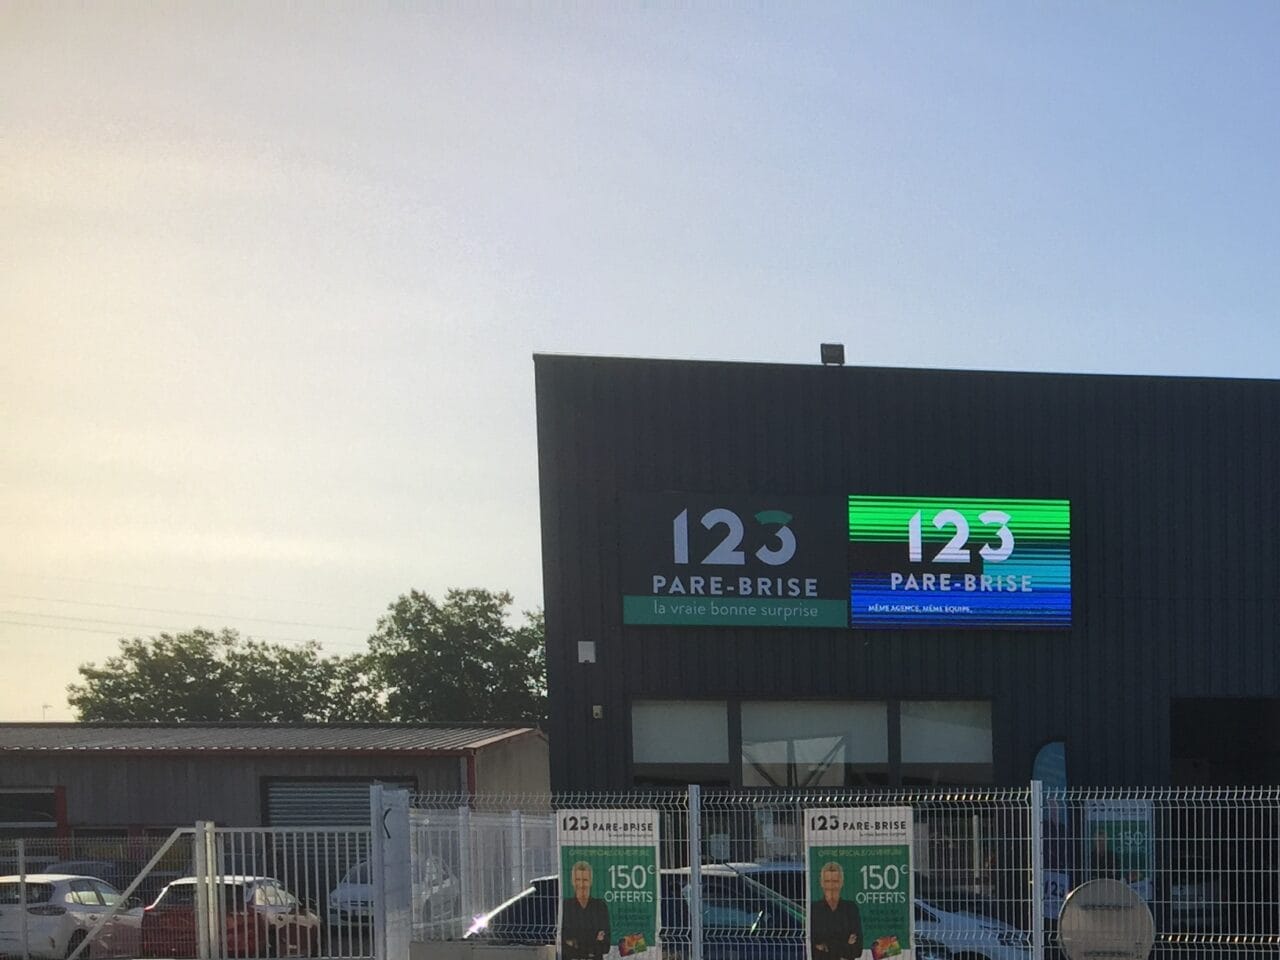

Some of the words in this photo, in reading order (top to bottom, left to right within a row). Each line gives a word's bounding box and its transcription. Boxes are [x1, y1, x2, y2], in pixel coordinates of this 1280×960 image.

[673, 508, 797, 566] 123
[908, 508, 1015, 563] 123
[652, 575, 818, 597] PARE-BRISE
[890, 573, 1033, 593] PARE-BRISE
[654, 600, 667, 614] la
[671, 601, 706, 615] vraie
[711, 602, 757, 616] bonne
[761, 602, 818, 620] surprise
[563, 816, 590, 831] 123
[592, 822, 654, 832] PARE-BRISE
[811, 815, 839, 831] 123
[843, 821, 907, 831] PARE-BRISE
[604, 890, 653, 903] OFFERTS
[855, 891, 906, 904] OFFERTS
